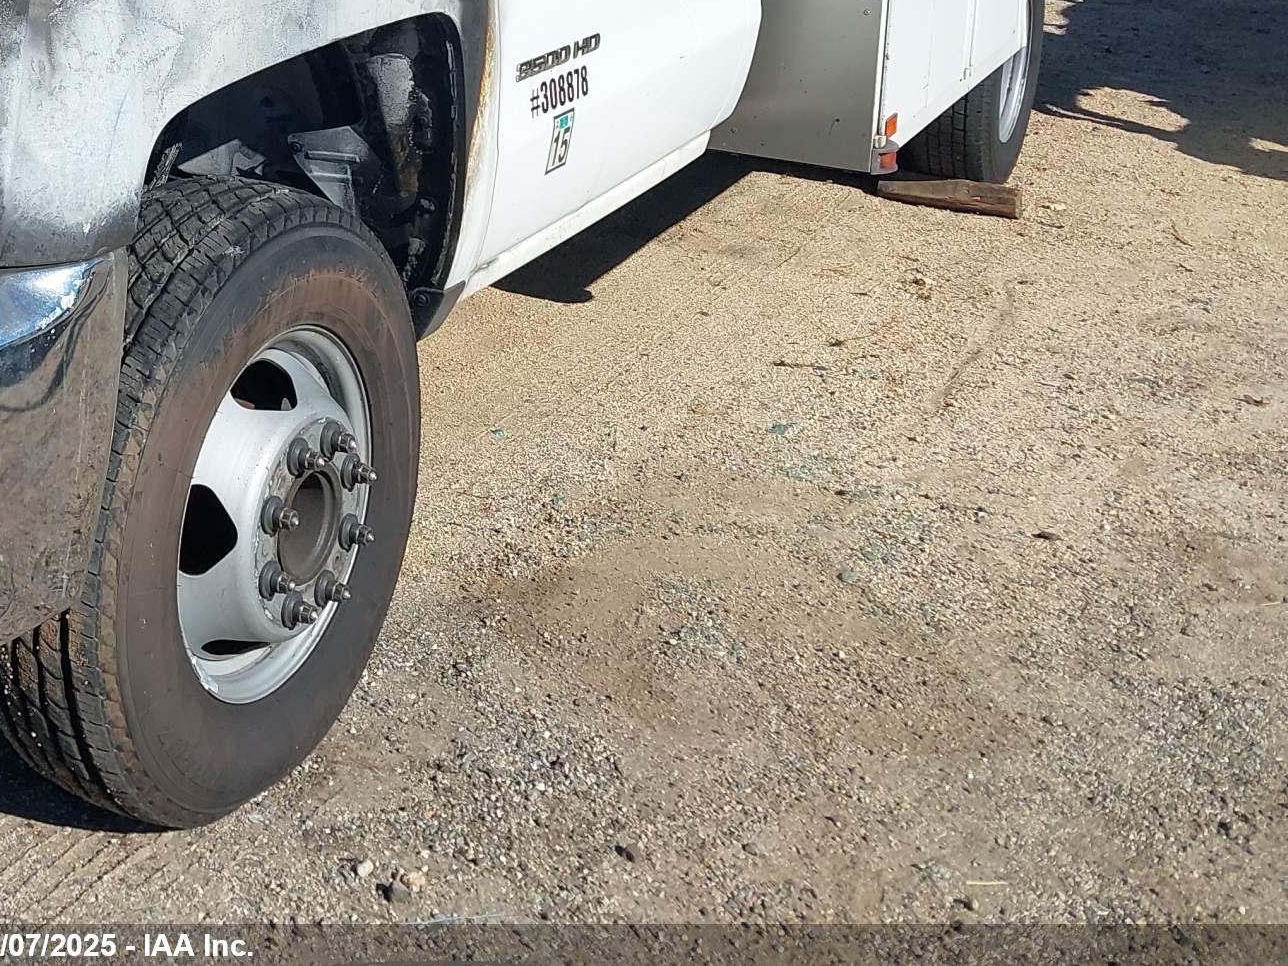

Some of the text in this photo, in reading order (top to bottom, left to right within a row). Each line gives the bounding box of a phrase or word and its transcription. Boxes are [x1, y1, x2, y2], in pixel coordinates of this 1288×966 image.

[573, 32, 601, 60] HD
[530, 65, 589, 119] #308878
[552, 127, 571, 167] 15
